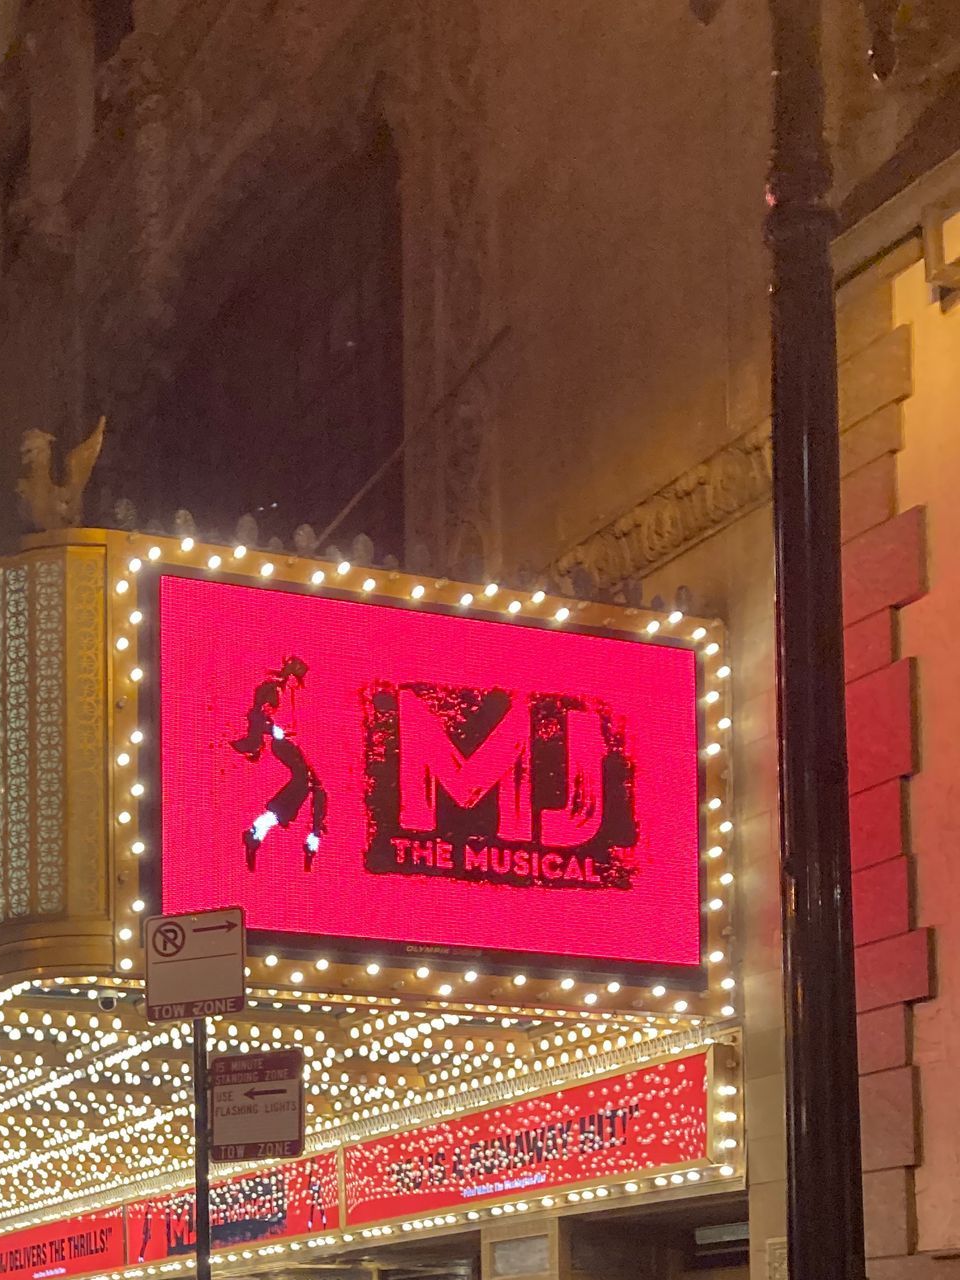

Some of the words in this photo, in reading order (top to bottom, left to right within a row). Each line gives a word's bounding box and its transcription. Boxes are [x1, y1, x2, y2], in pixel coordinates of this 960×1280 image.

[397, 684, 605, 848] MJ
[391, 836, 454, 869] THE
[464, 846, 601, 884] MUSICAL
[152, 1003, 185, 1020] TOW
[192, 998, 237, 1016] ZONE
[231, 1057, 264, 1071] MINUTE
[215, 1071, 259, 1085] STANDING
[264, 1068, 288, 1080] ZONE
[216, 1091, 233, 1103] USE
[215, 1104, 259, 1118] FLASHING
[265, 1101, 297, 1114] LIGHTS
[220, 1145, 246, 1160] TOW
[257, 1141, 292, 1156] ZONE
[9, 1242, 47, 1272] DELIVERS
[49, 1238, 65, 1263] THE
